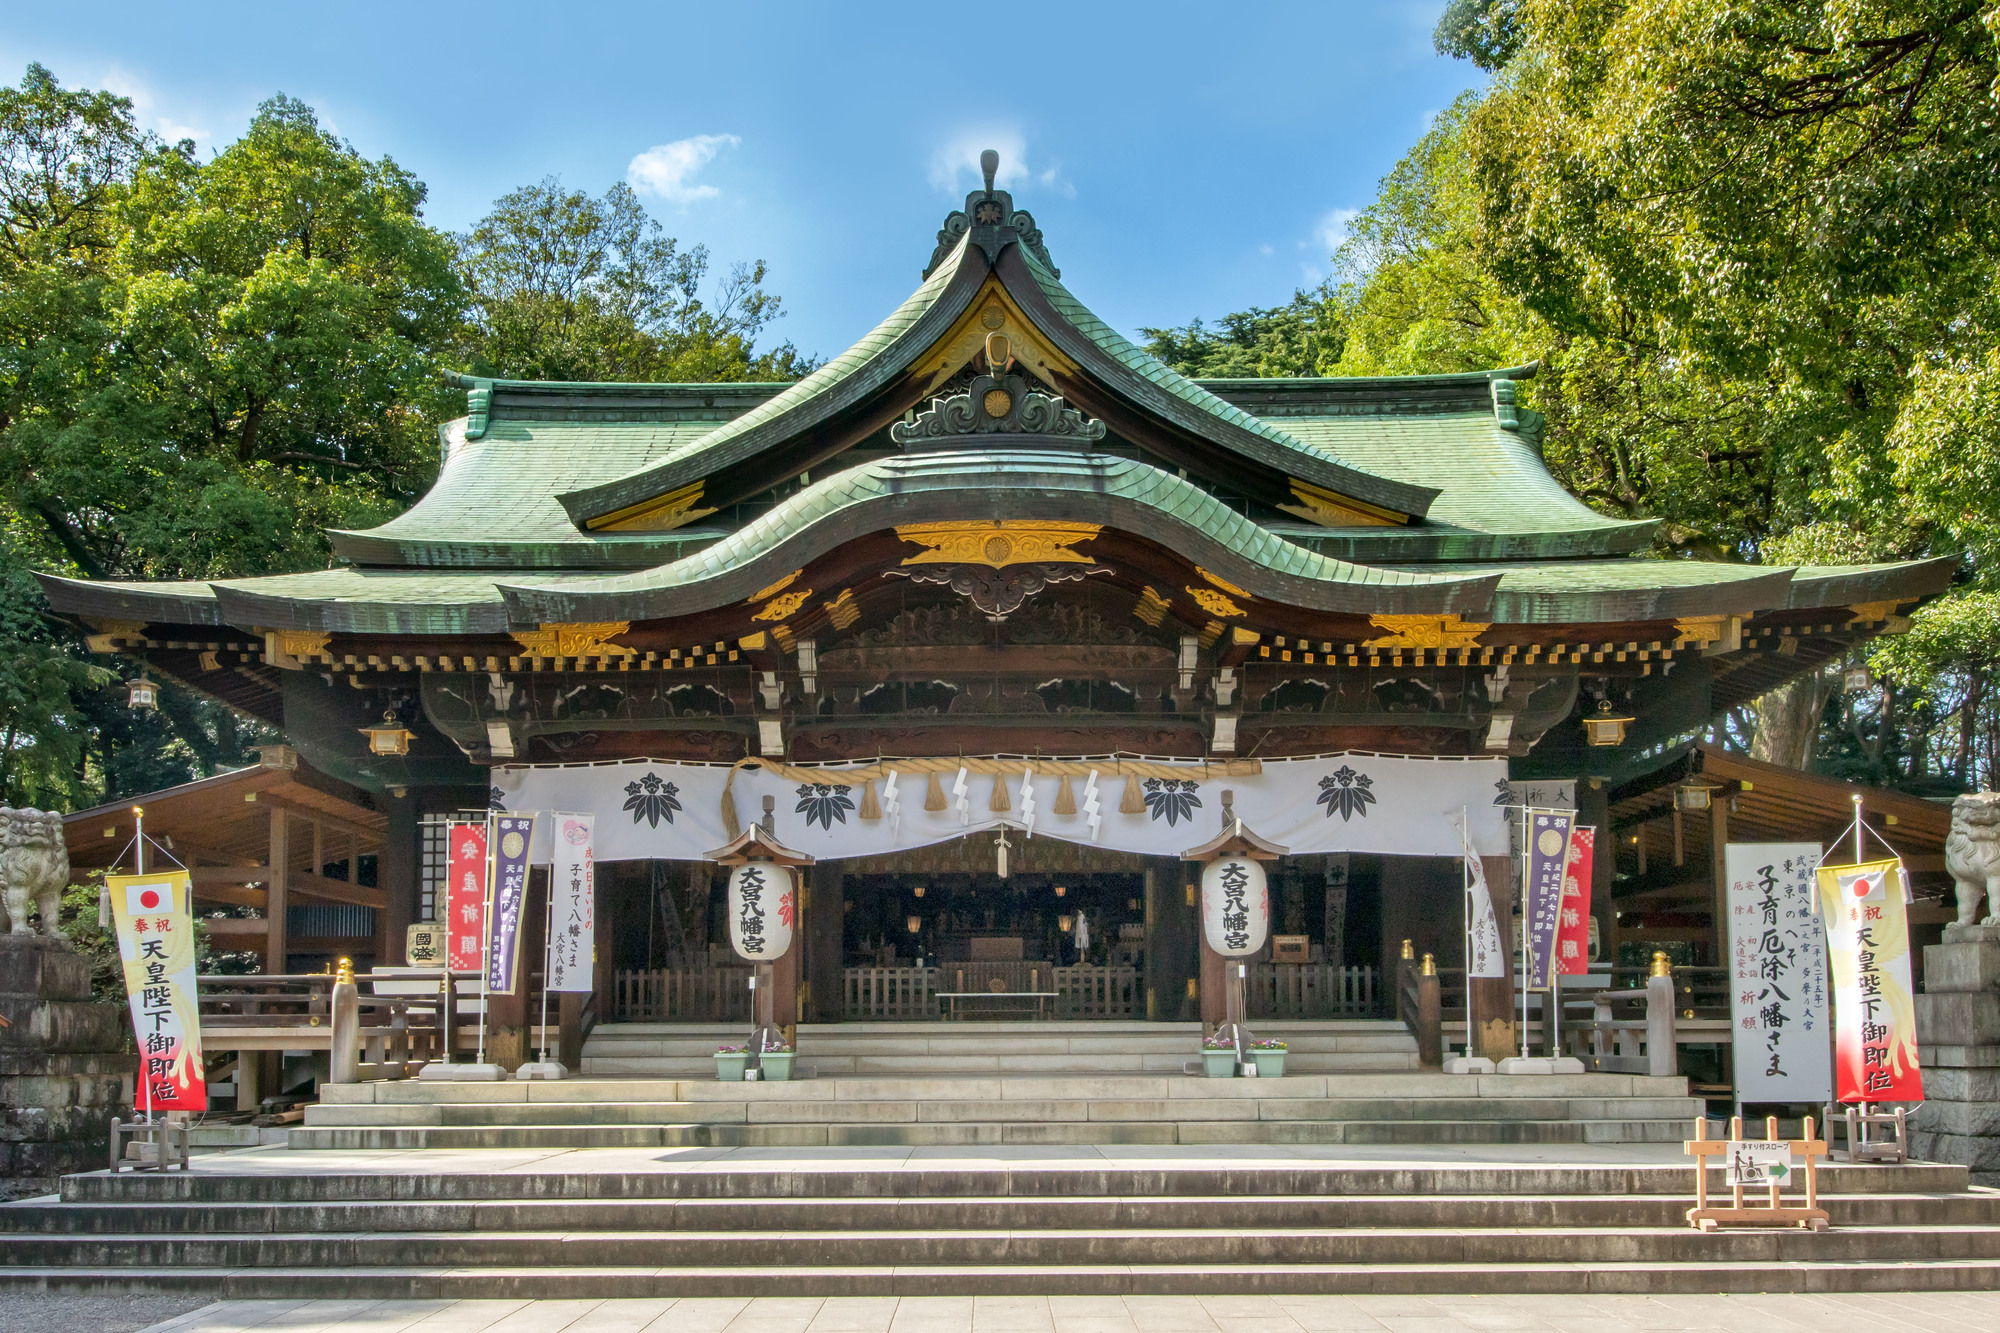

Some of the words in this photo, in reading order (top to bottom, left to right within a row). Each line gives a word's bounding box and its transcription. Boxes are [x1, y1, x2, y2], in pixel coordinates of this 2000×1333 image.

[1556, 787, 1569, 802] 大
[500, 819, 530, 831] 奉祝
[1537, 816, 1567, 829] 奉祝
[568, 863, 583, 968] 子育て八幡さま
[738, 867, 767, 954] 大宮八幡宮
[1219, 862, 1250, 950] 大宮八幡宮
[1544, 863, 1562, 931] 皇紀二六七九年
[1782, 858, 1799, 968] 東京のへそ
[1849, 905, 1883, 921] 奉祝
[134, 917, 173, 935] 奉祝
[1475, 918, 1487, 973] 大宮八幡宮
[554, 932, 566, 987] 大宮八幡宮
[1757, 864, 1791, 1078] 子育厄除八幡さま
[141, 939, 179, 1102] 天皇陛下御即位
[1740, 990, 1757, 1030] 祈願
[1855, 927, 1894, 1094] 天皇陛下御即位
[1741, 1143, 1790, 1151] 手すり付スロープ
